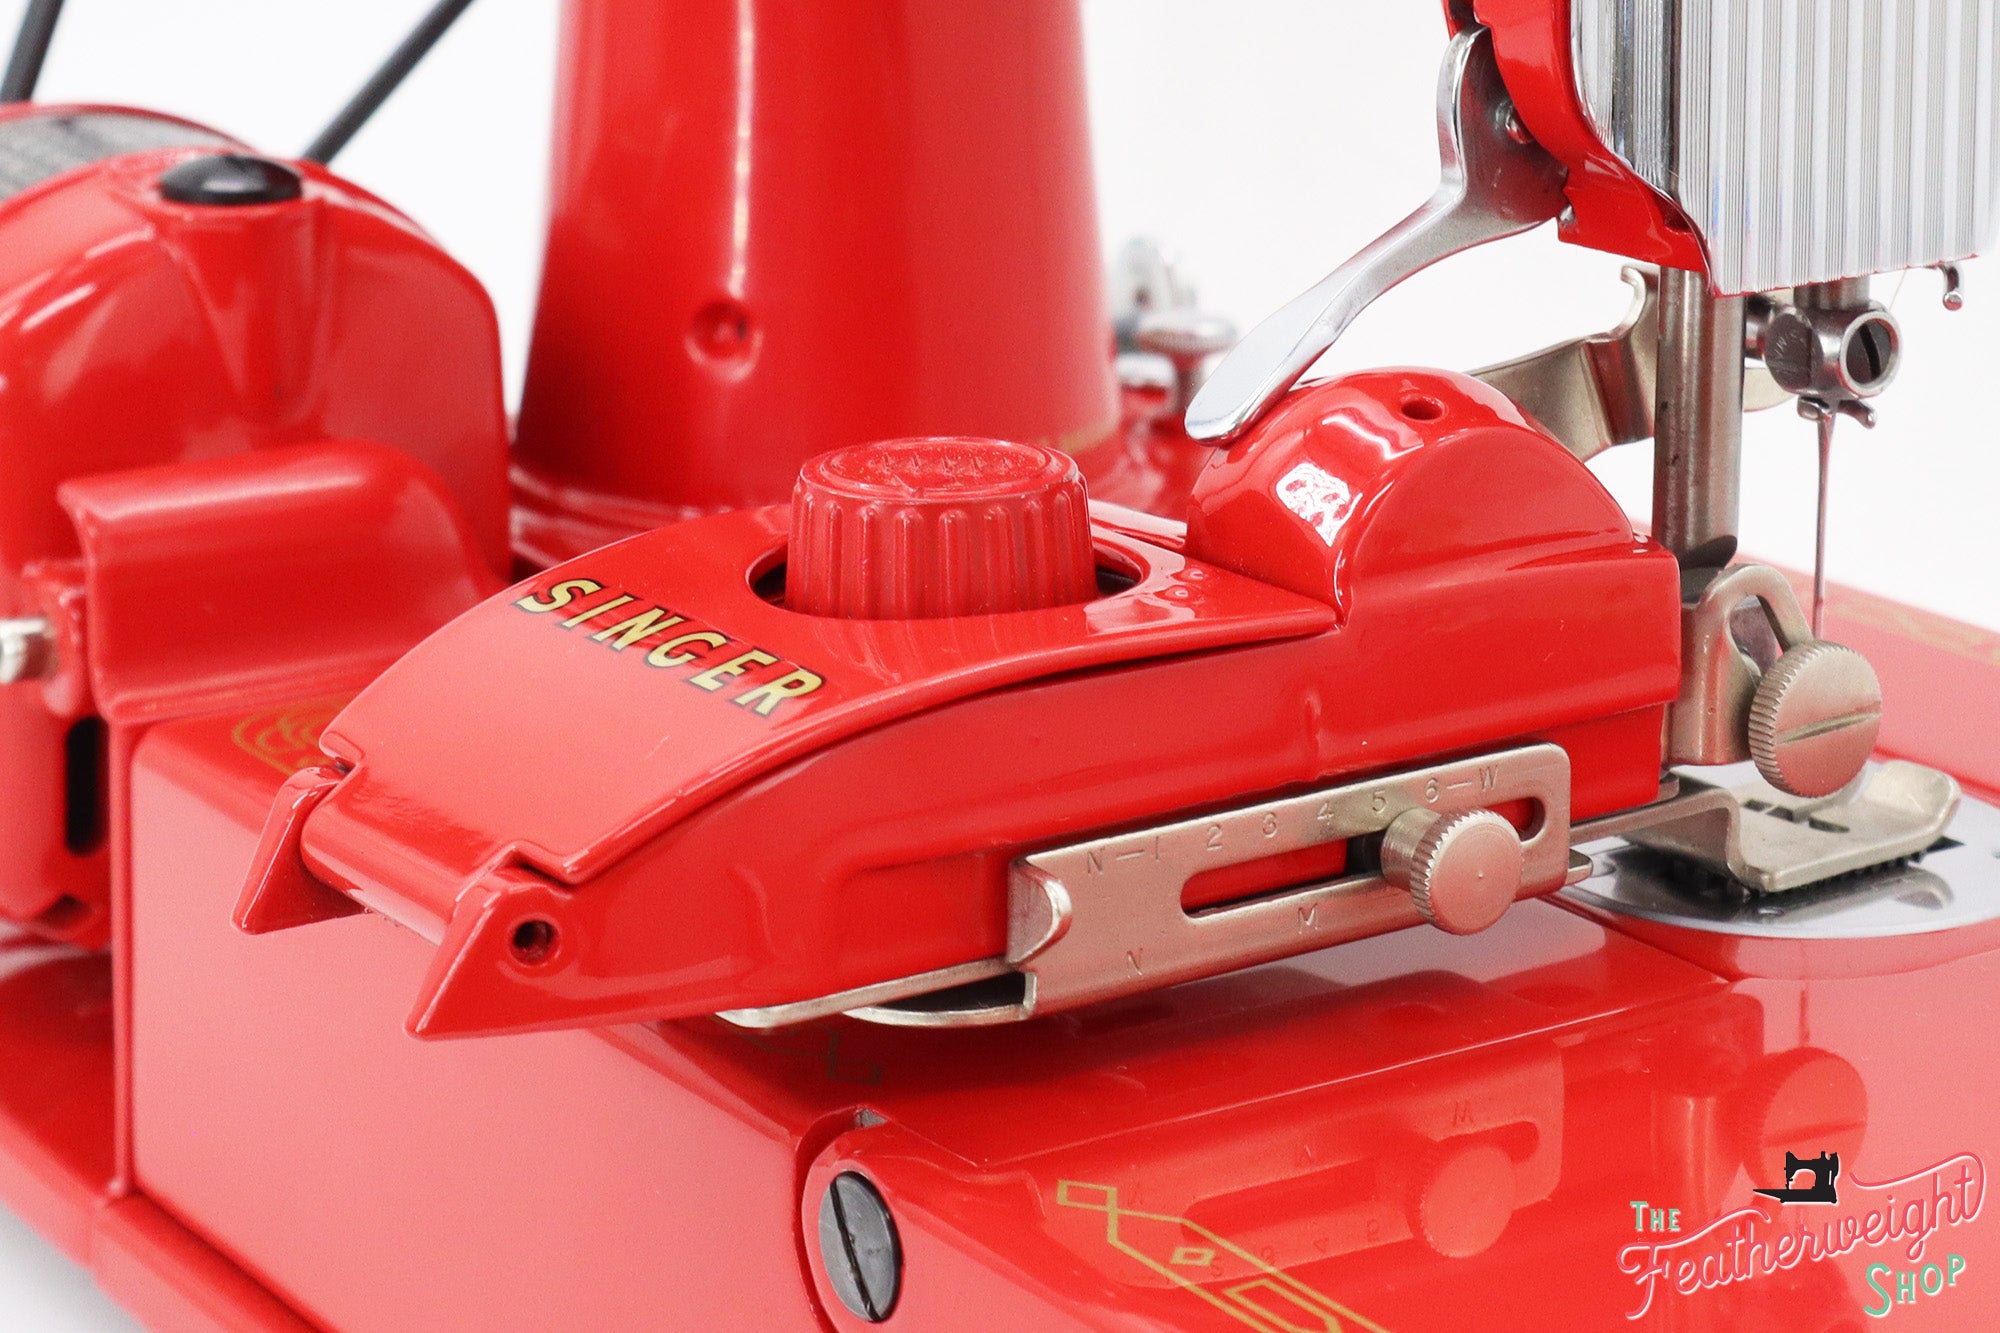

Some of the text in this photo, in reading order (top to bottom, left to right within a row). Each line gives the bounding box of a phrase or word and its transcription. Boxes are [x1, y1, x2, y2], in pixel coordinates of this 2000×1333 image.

[513, 579, 826, 718] SINGER
[1206, 823, 1223, 852] 2
[1262, 811, 1278, 839] 3
[1317, 801, 1335, 826] 4
[1372, 790, 1387, 815] 5
[1126, 902, 1319, 980] N M
